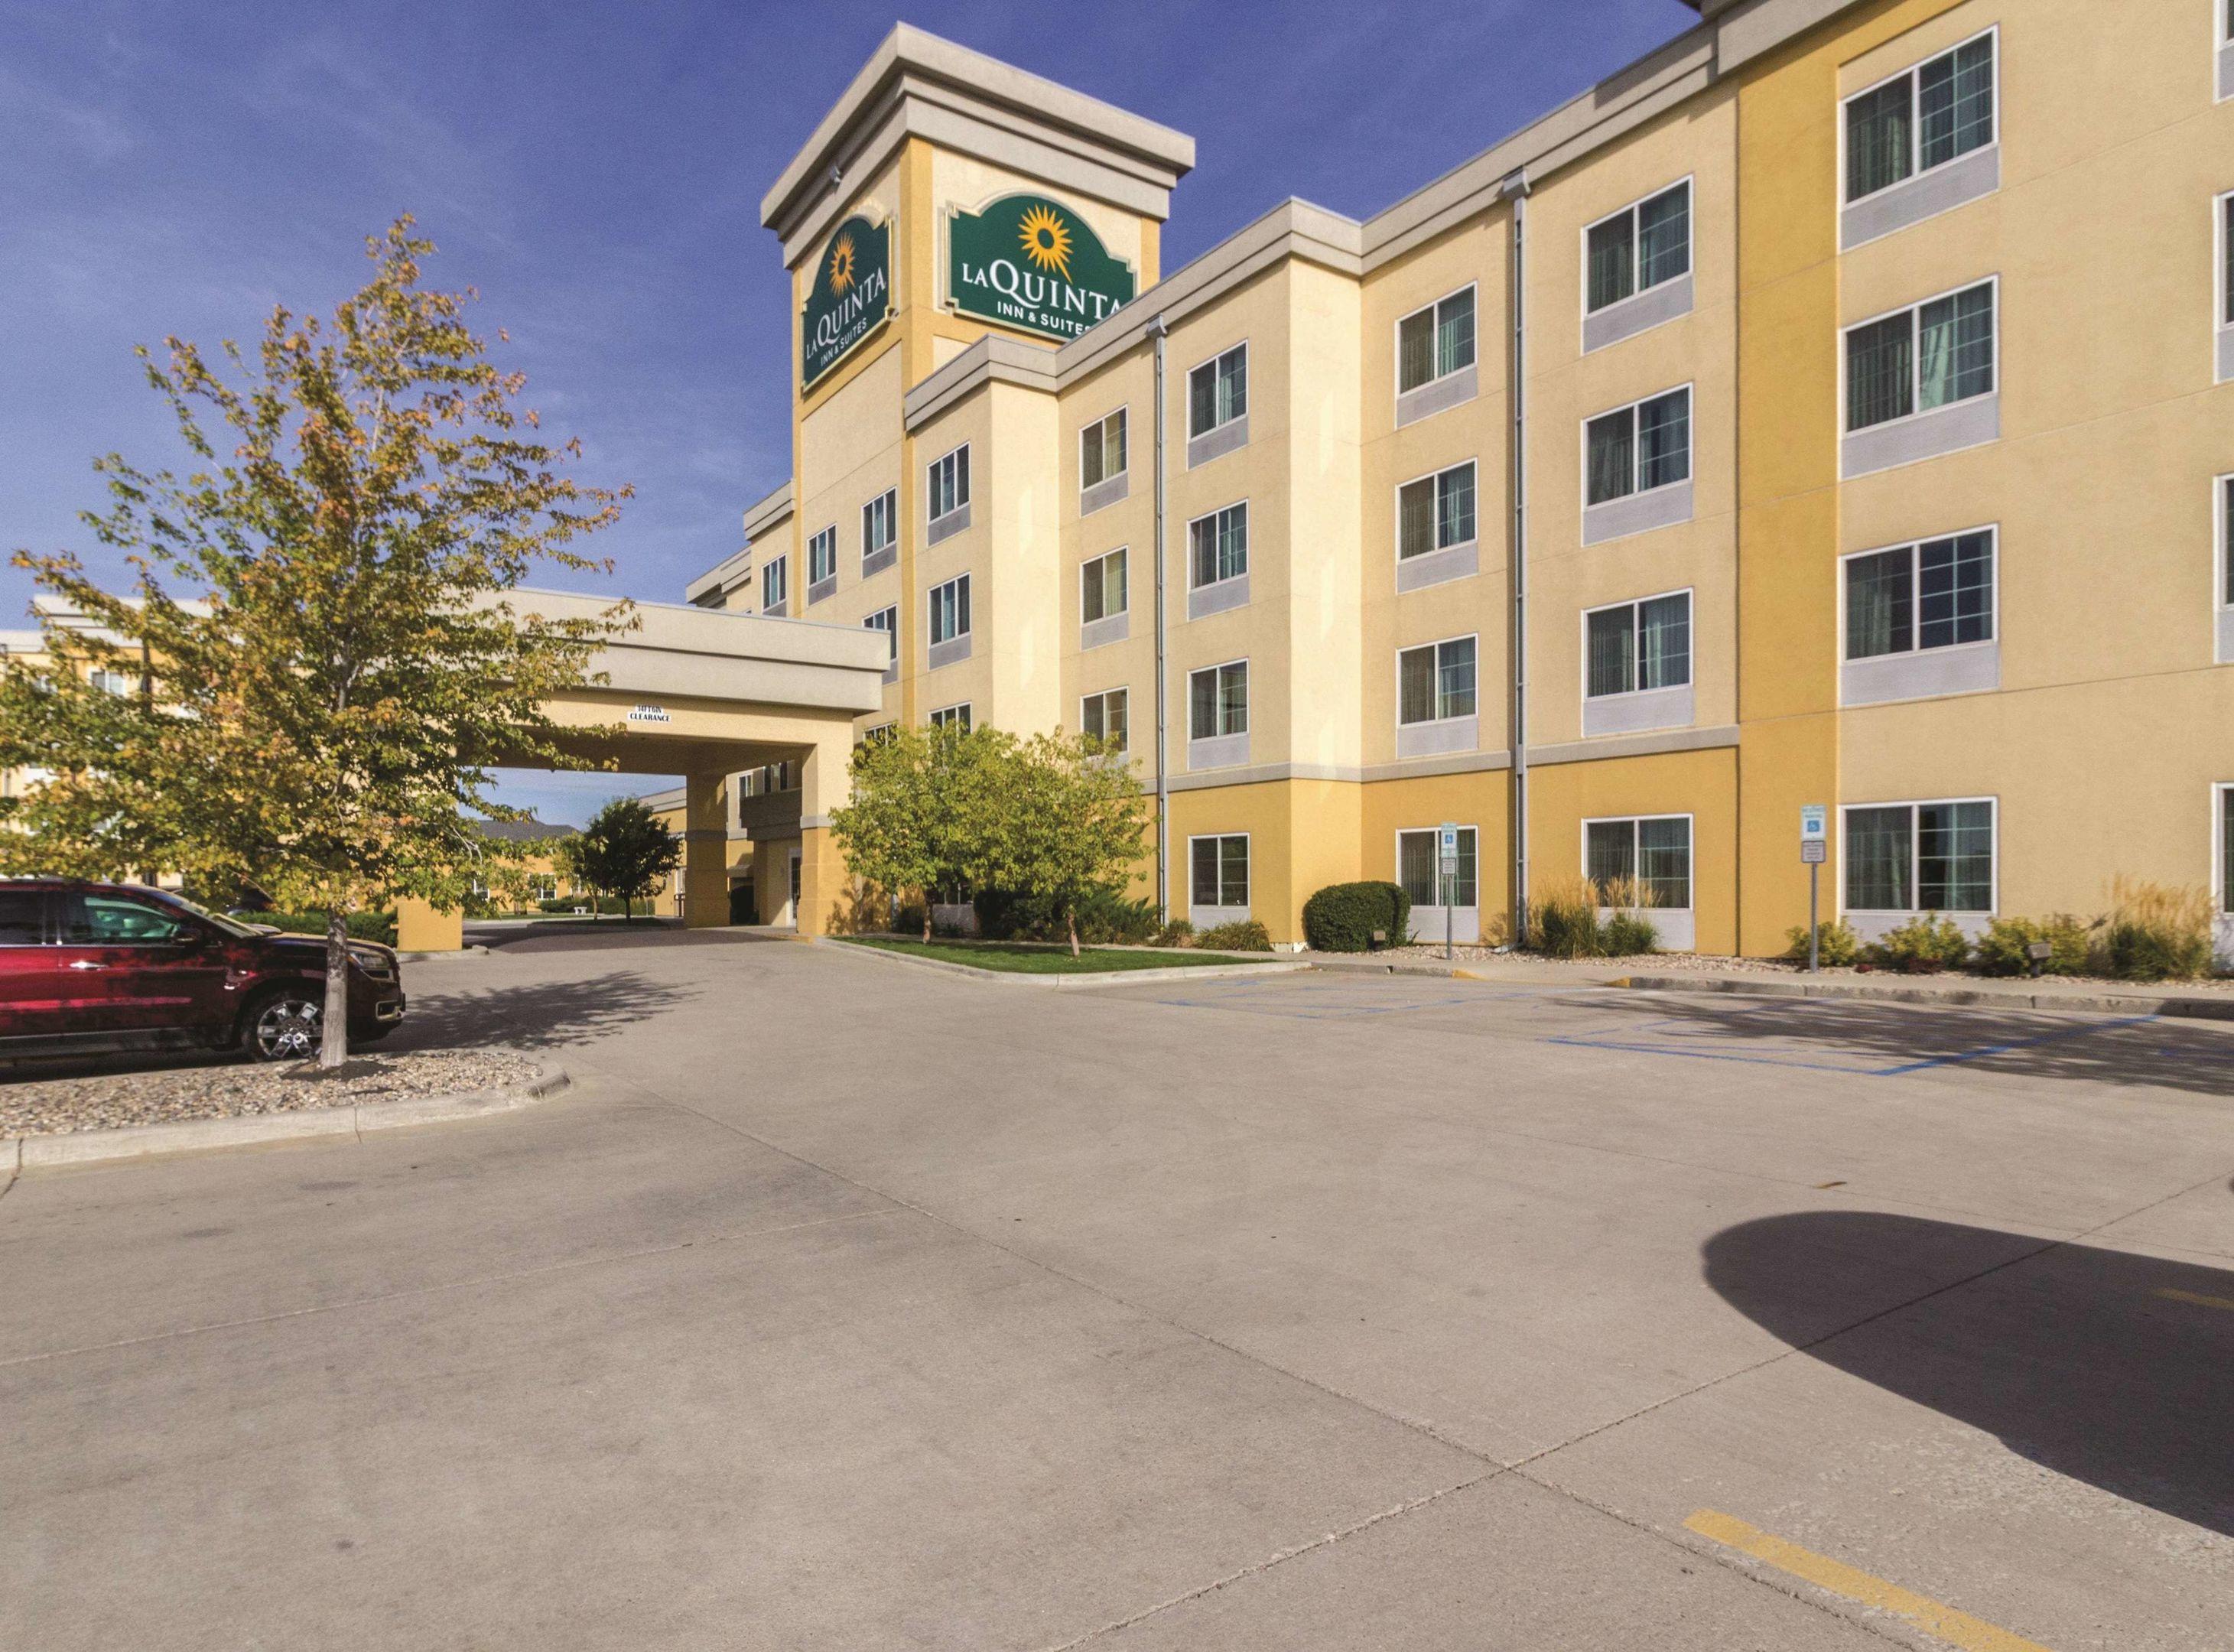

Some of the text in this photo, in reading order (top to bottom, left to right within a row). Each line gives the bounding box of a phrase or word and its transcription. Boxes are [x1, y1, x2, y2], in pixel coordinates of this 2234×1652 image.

[962, 262, 989, 288] LA
[806, 267, 886, 359] LA QUINTA
[997, 301, 1091, 336] INN & SUITE
[821, 317, 867, 366] INN & SUITES
[629, 713, 670, 723] CLEARANCE
